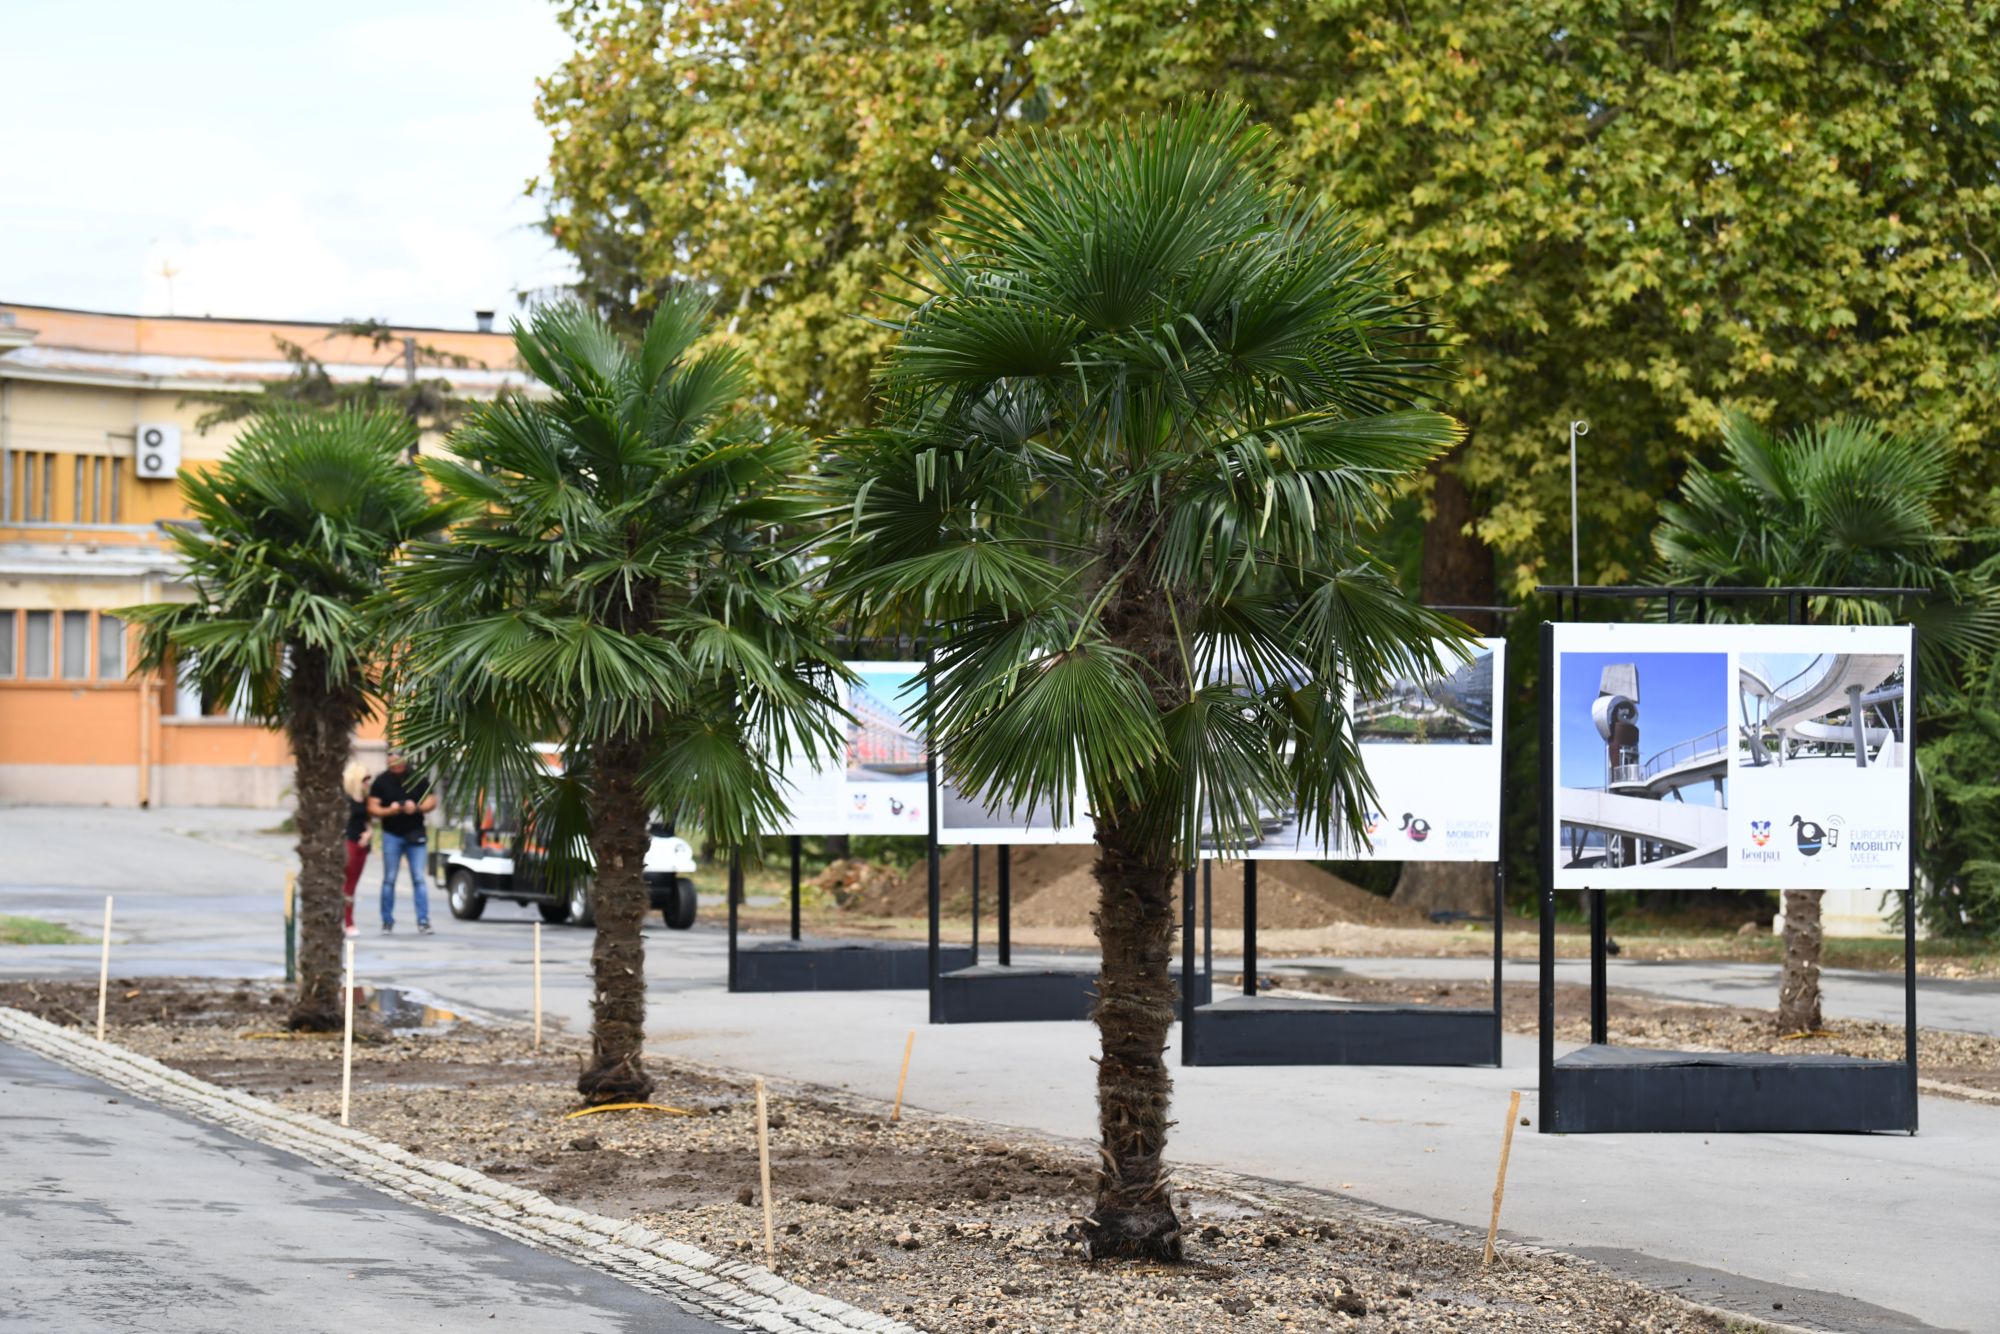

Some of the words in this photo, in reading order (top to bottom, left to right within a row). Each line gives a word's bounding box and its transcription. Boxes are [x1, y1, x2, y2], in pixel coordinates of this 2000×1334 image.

[1446, 830, 1490, 839] MOBILITY
[1850, 829, 1904, 840] EUROPEAN
[1850, 841, 1902, 851] MOBILITY
[1850, 853, 1879, 863] WEEK
